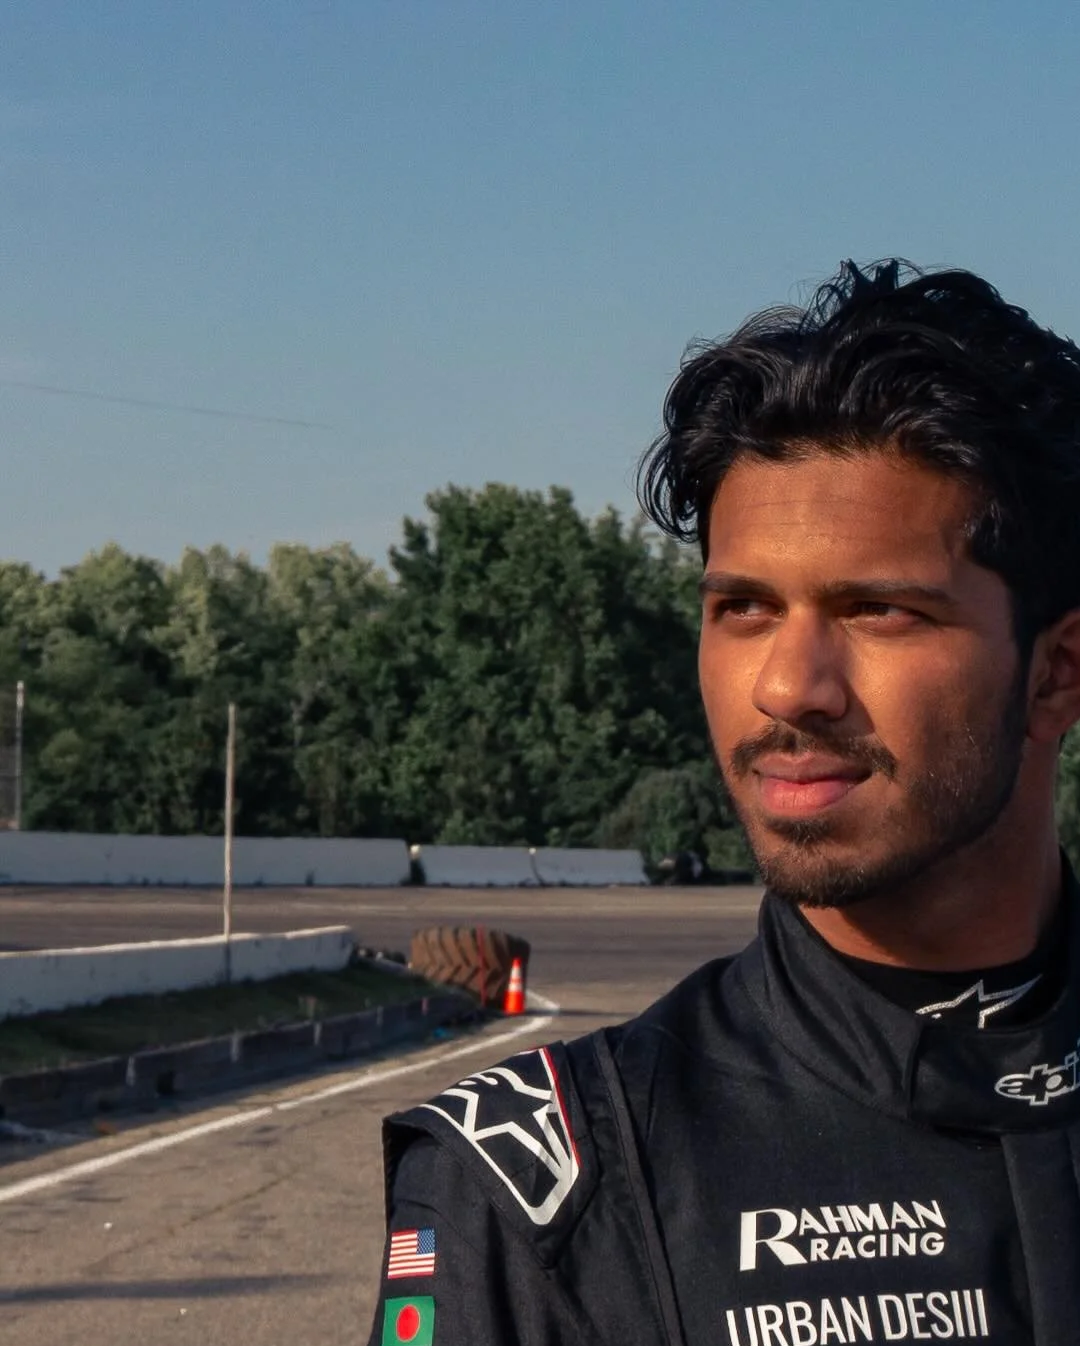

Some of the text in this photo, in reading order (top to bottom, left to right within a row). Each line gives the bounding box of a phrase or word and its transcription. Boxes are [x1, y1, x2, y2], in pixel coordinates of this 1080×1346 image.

[739, 1199, 947, 1271] RAHMAN
[809, 1232, 945, 1262] RACING
[877, 1288, 990, 1341] DESIII
